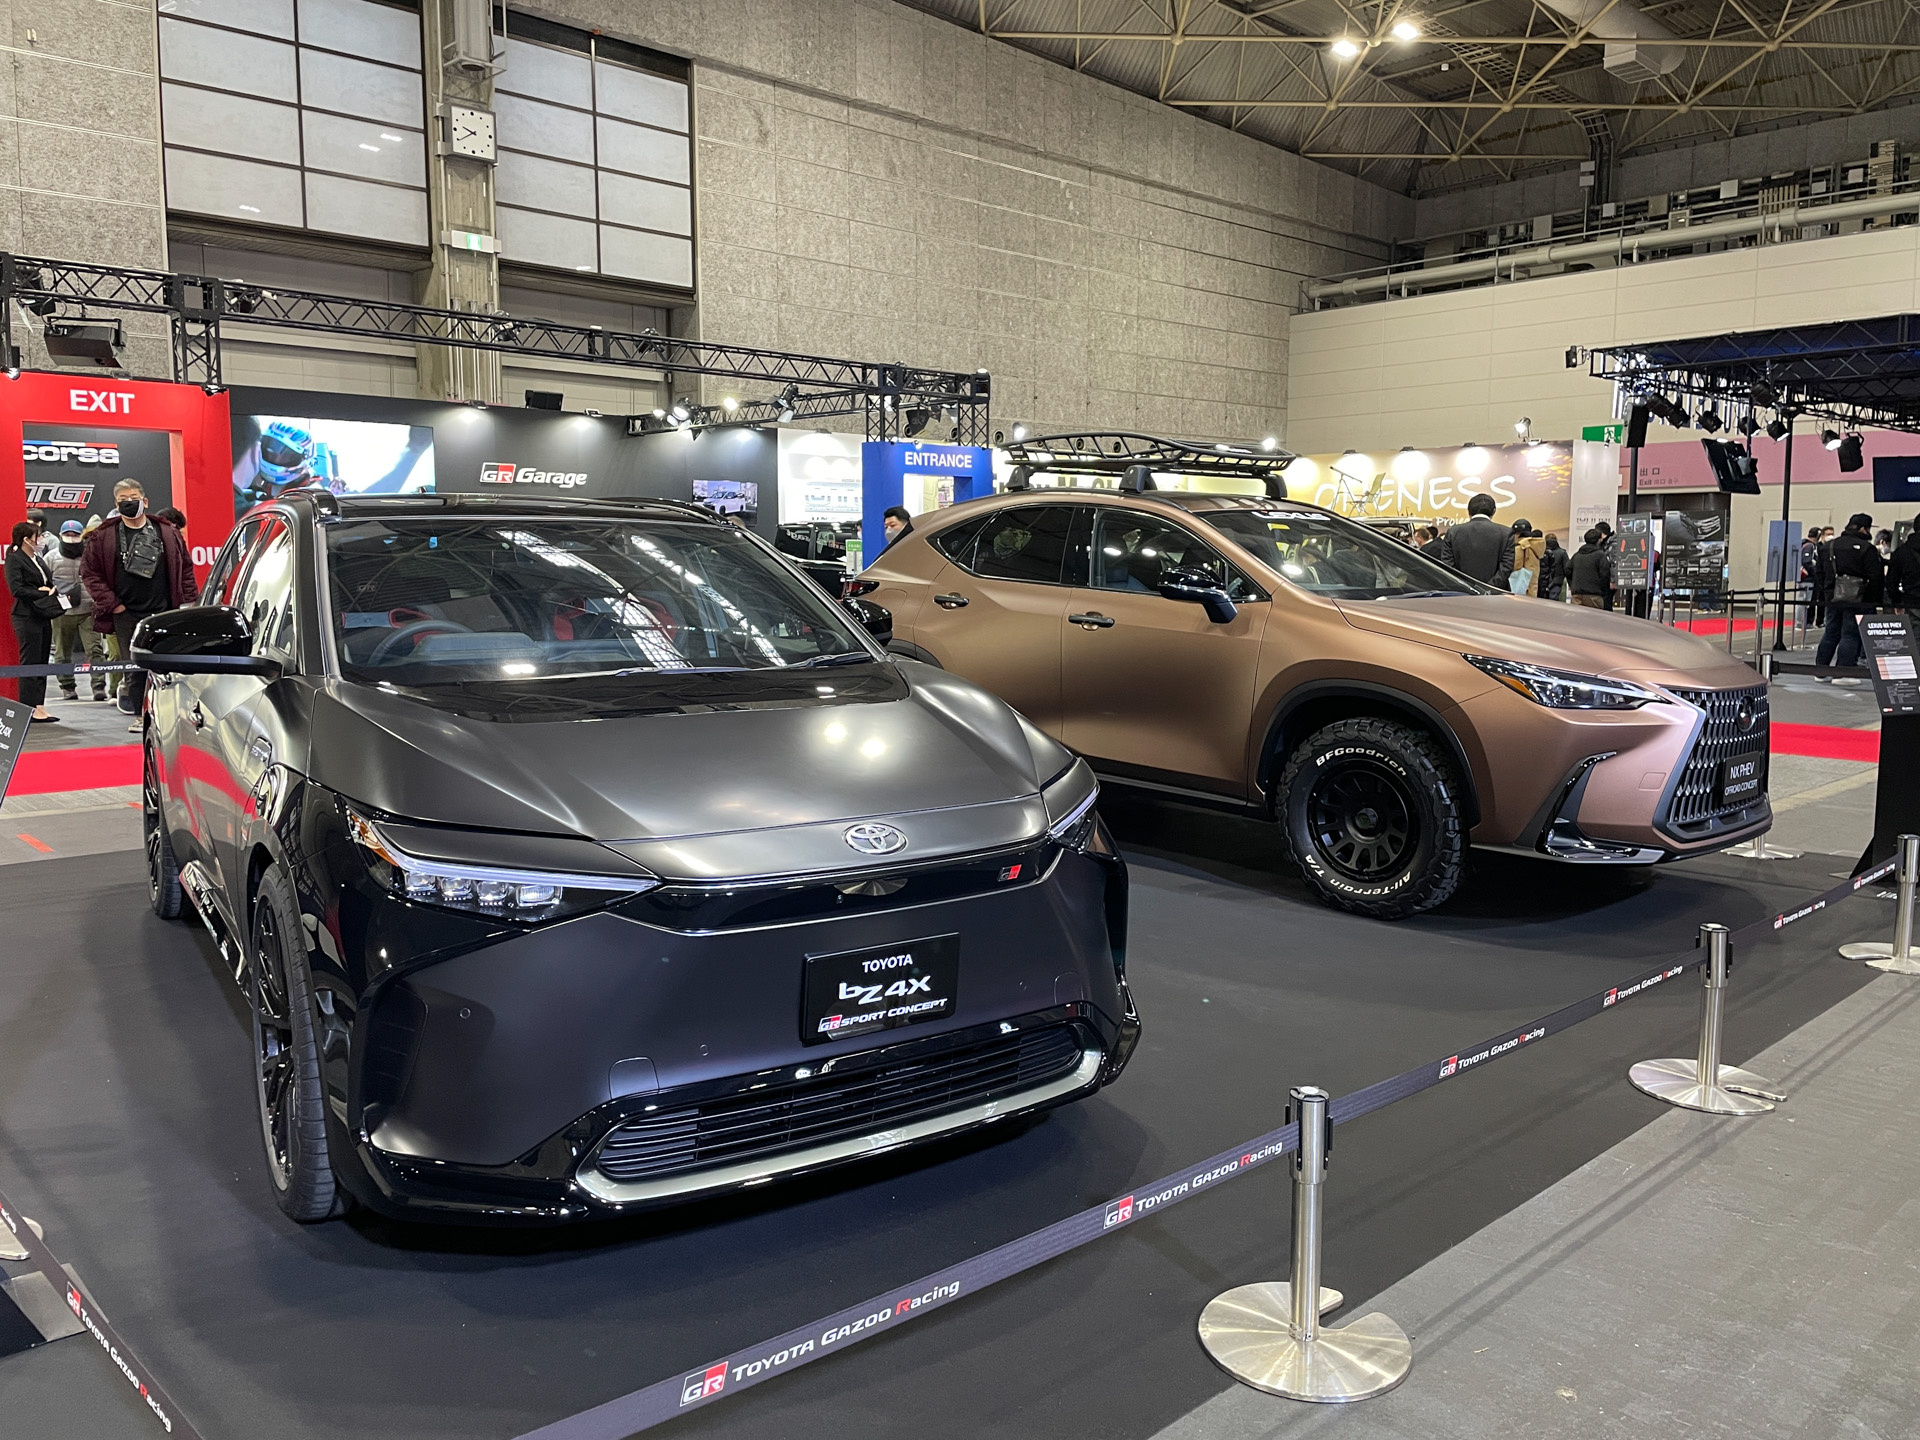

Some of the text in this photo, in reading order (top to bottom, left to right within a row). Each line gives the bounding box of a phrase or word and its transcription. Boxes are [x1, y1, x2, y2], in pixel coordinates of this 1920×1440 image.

[70, 389, 135, 414] EXIT
[23, 445, 119, 464] corsa
[905, 452, 972, 468] ENTRANCE
[482, 467, 588, 488] GR Garage
[1316, 748, 1407, 776] BFGoodrich
[1730, 761, 1755, 779] NX PHEV
[1305, 854, 1411, 895] All-Terrain T/A
[862, 953, 913, 973] TOYOTA
[1603, 965, 1683, 1006] GR TOYOTA GAZOO Racing
[819, 998, 948, 1031] GR SPORT CONCEPT
[1440, 1027, 1545, 1077] GR TOYOTA GAZOO Racing
[1105, 1142, 1283, 1226] GR TOYOTA GAZOO Racing
[682, 1281, 960, 1404] GR TOYOTA GAZOO Racing
[66, 1288, 172, 1433] GR TOYOTA GAZOO Racing
